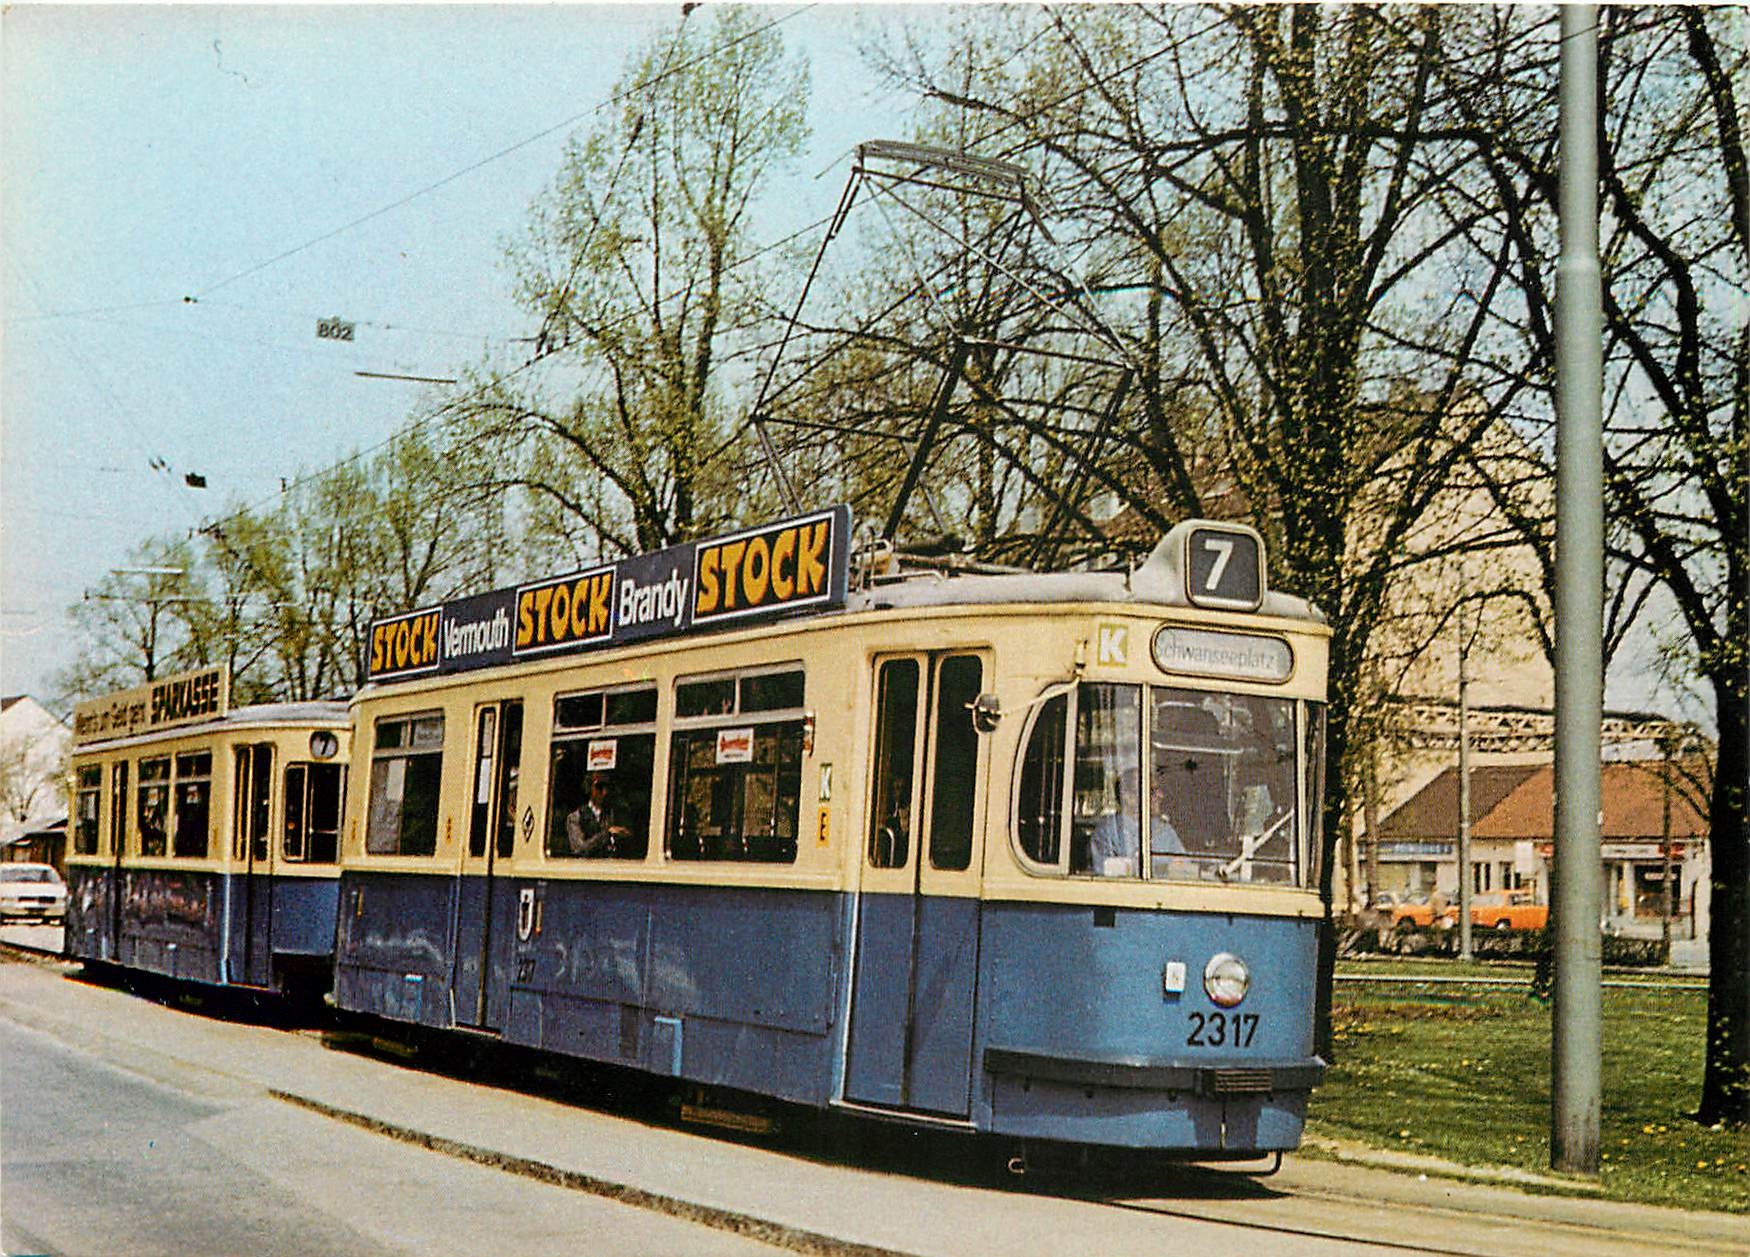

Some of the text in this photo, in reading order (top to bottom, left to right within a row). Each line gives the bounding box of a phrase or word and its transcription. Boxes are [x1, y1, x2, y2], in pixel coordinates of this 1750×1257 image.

[697, 522, 829, 614] STOCK
[1205, 539, 1233, 590] 7
[517, 574, 612, 647] STOCK
[619, 571, 689, 627] Brandy
[371, 612, 437, 673] STOCK
[443, 611, 509, 658] Vermouth
[1100, 629, 1127, 663] K
[319, 736, 330, 755] 7
[1187, 1012, 1260, 1047] 2317
